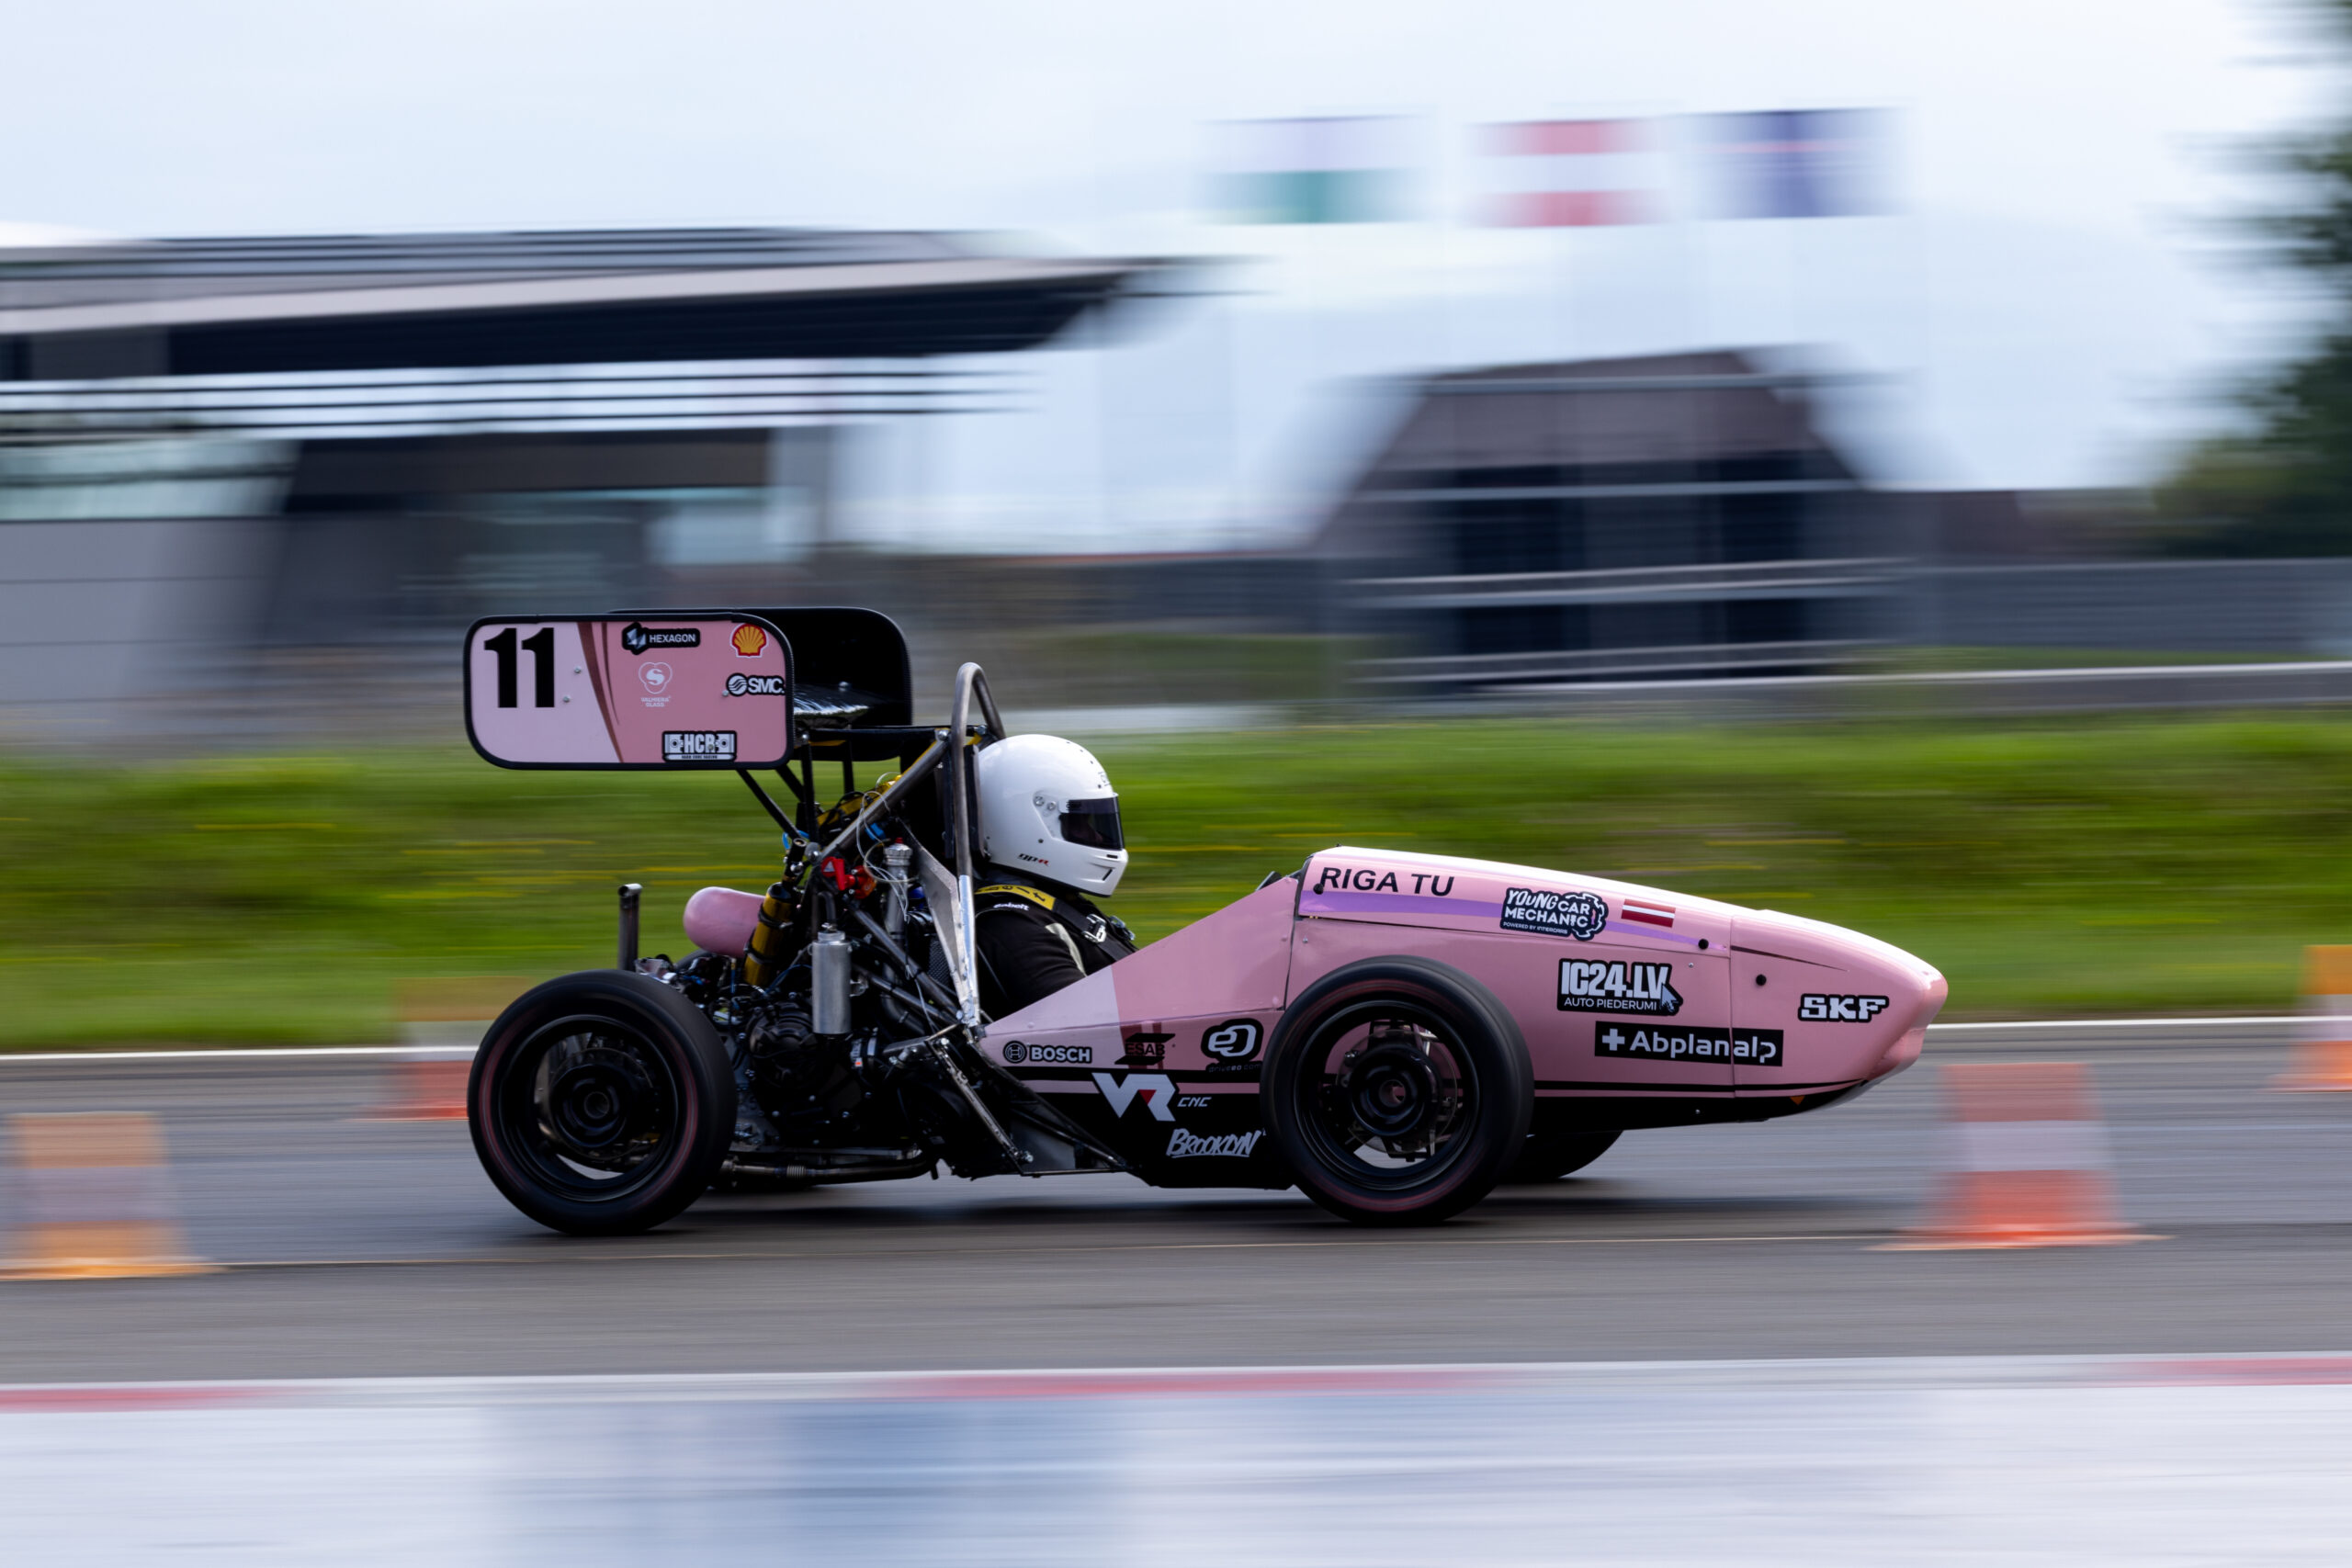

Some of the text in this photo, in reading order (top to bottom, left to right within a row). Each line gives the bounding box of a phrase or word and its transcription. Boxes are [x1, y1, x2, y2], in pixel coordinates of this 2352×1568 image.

[649, 633, 696, 643] HEXAGON
[483, 627, 555, 708] 11
[684, 733, 716, 753] HCR
[1318, 866, 1454, 897] RIGA TU
[1507, 889, 1590, 915] YOUNG CAR
[1502, 921, 1529, 930] POWERED
[1504, 906, 1589, 928] MECHANIC
[1561, 961, 1669, 999] IC24.LV
[1564, 997, 1657, 1011] AUTO PIEDERUMI
[1801, 997, 1886, 1020] SKF
[1031, 1046, 1091, 1063] BOSCH
[1125, 1043, 1166, 1055] ESAB
[1629, 1030, 1777, 1064] Abplanalp
[1091, 1072, 1176, 1122] VR
